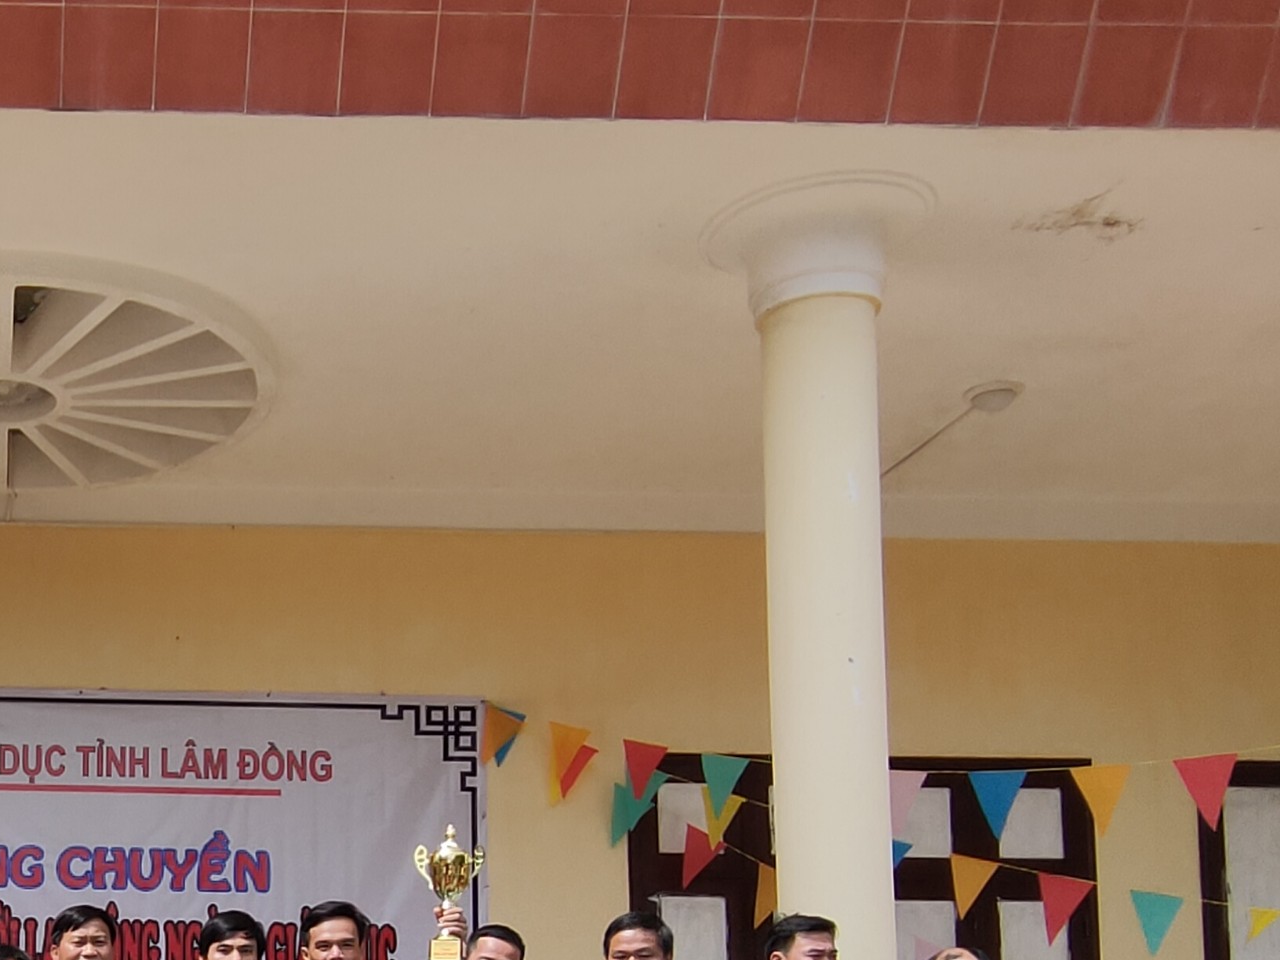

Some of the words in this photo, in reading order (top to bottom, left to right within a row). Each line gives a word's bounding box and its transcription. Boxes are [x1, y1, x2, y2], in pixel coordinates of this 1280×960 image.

[76, 738, 150, 778] TỈNH
[161, 738, 227, 780] LÂM
[56, 829, 271, 893] CHUYỀN
